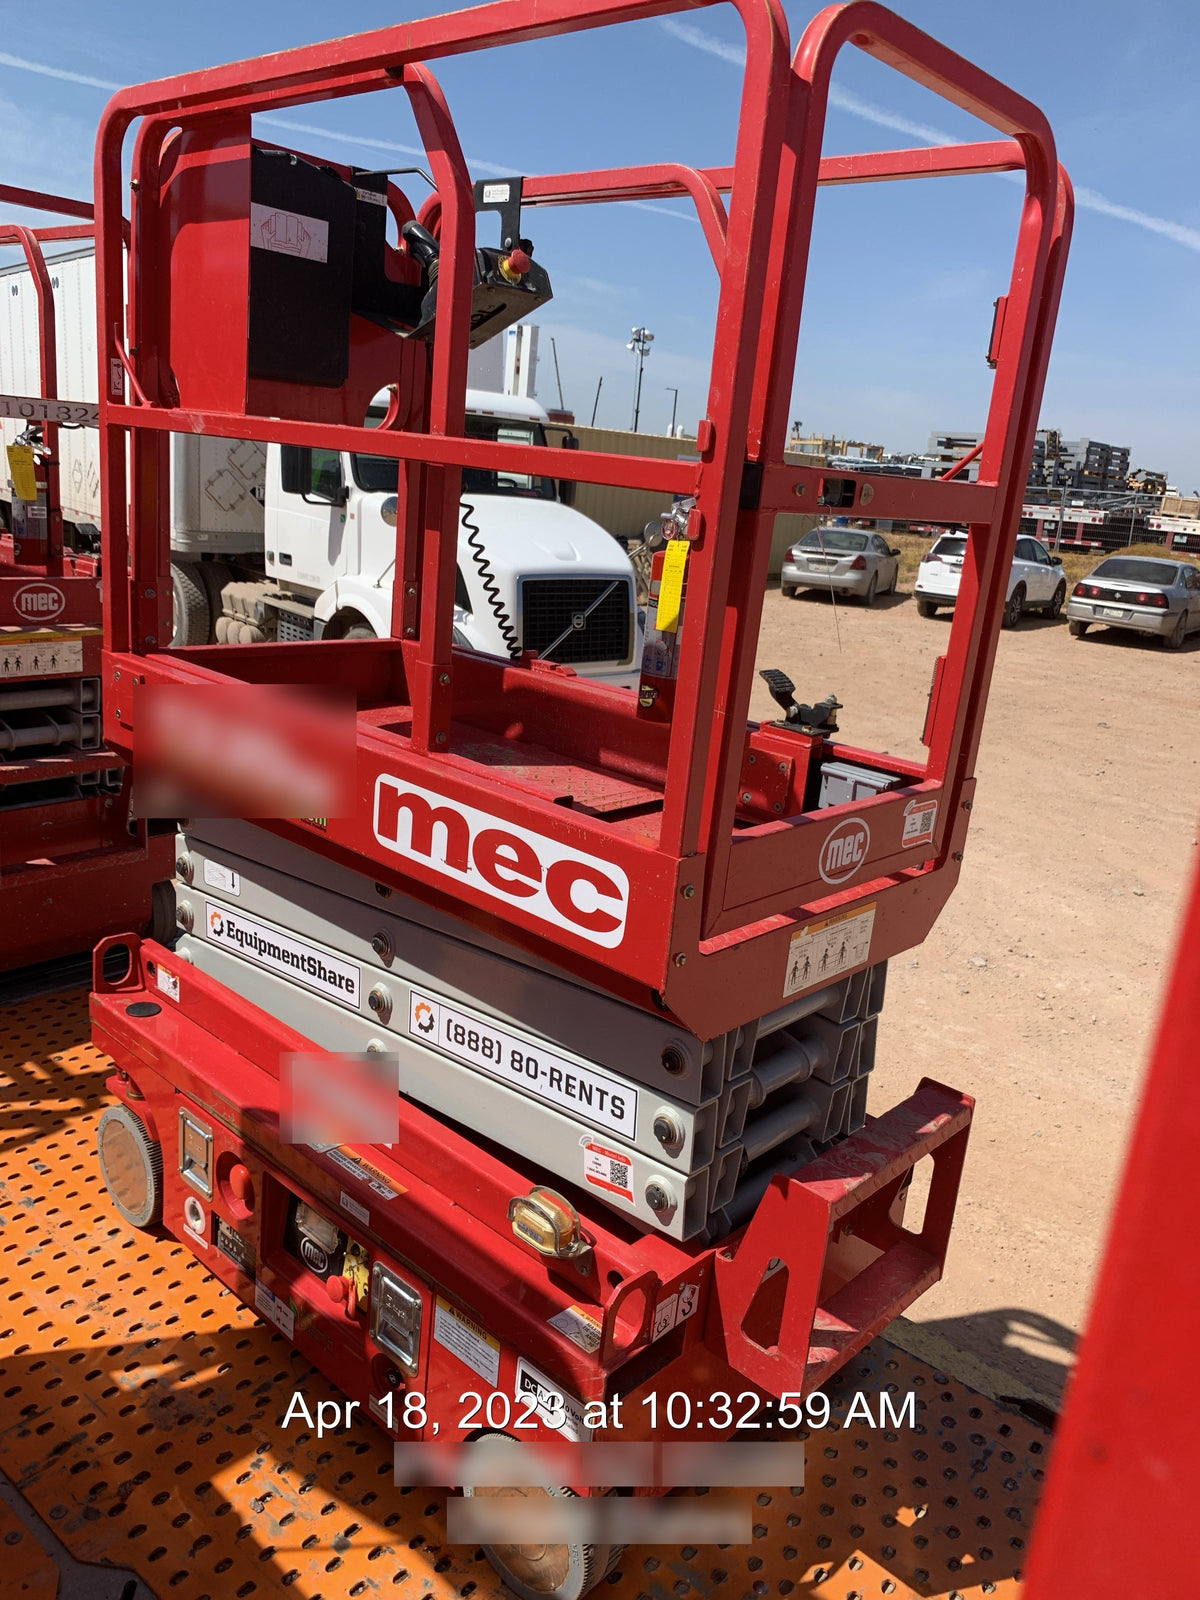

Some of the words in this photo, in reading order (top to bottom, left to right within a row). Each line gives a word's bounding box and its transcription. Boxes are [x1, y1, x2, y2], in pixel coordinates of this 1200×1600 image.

[377, 781, 623, 933] mec
[825, 832, 864, 871] mec
[226, 920, 355, 994] EquipmentShare
[446, 1018, 502, 1064] (888)
[510, 1050, 625, 1120] 80-RENTS
[363, 1162, 392, 1184] WARNING
[455, 1309, 488, 1340] WARNING
